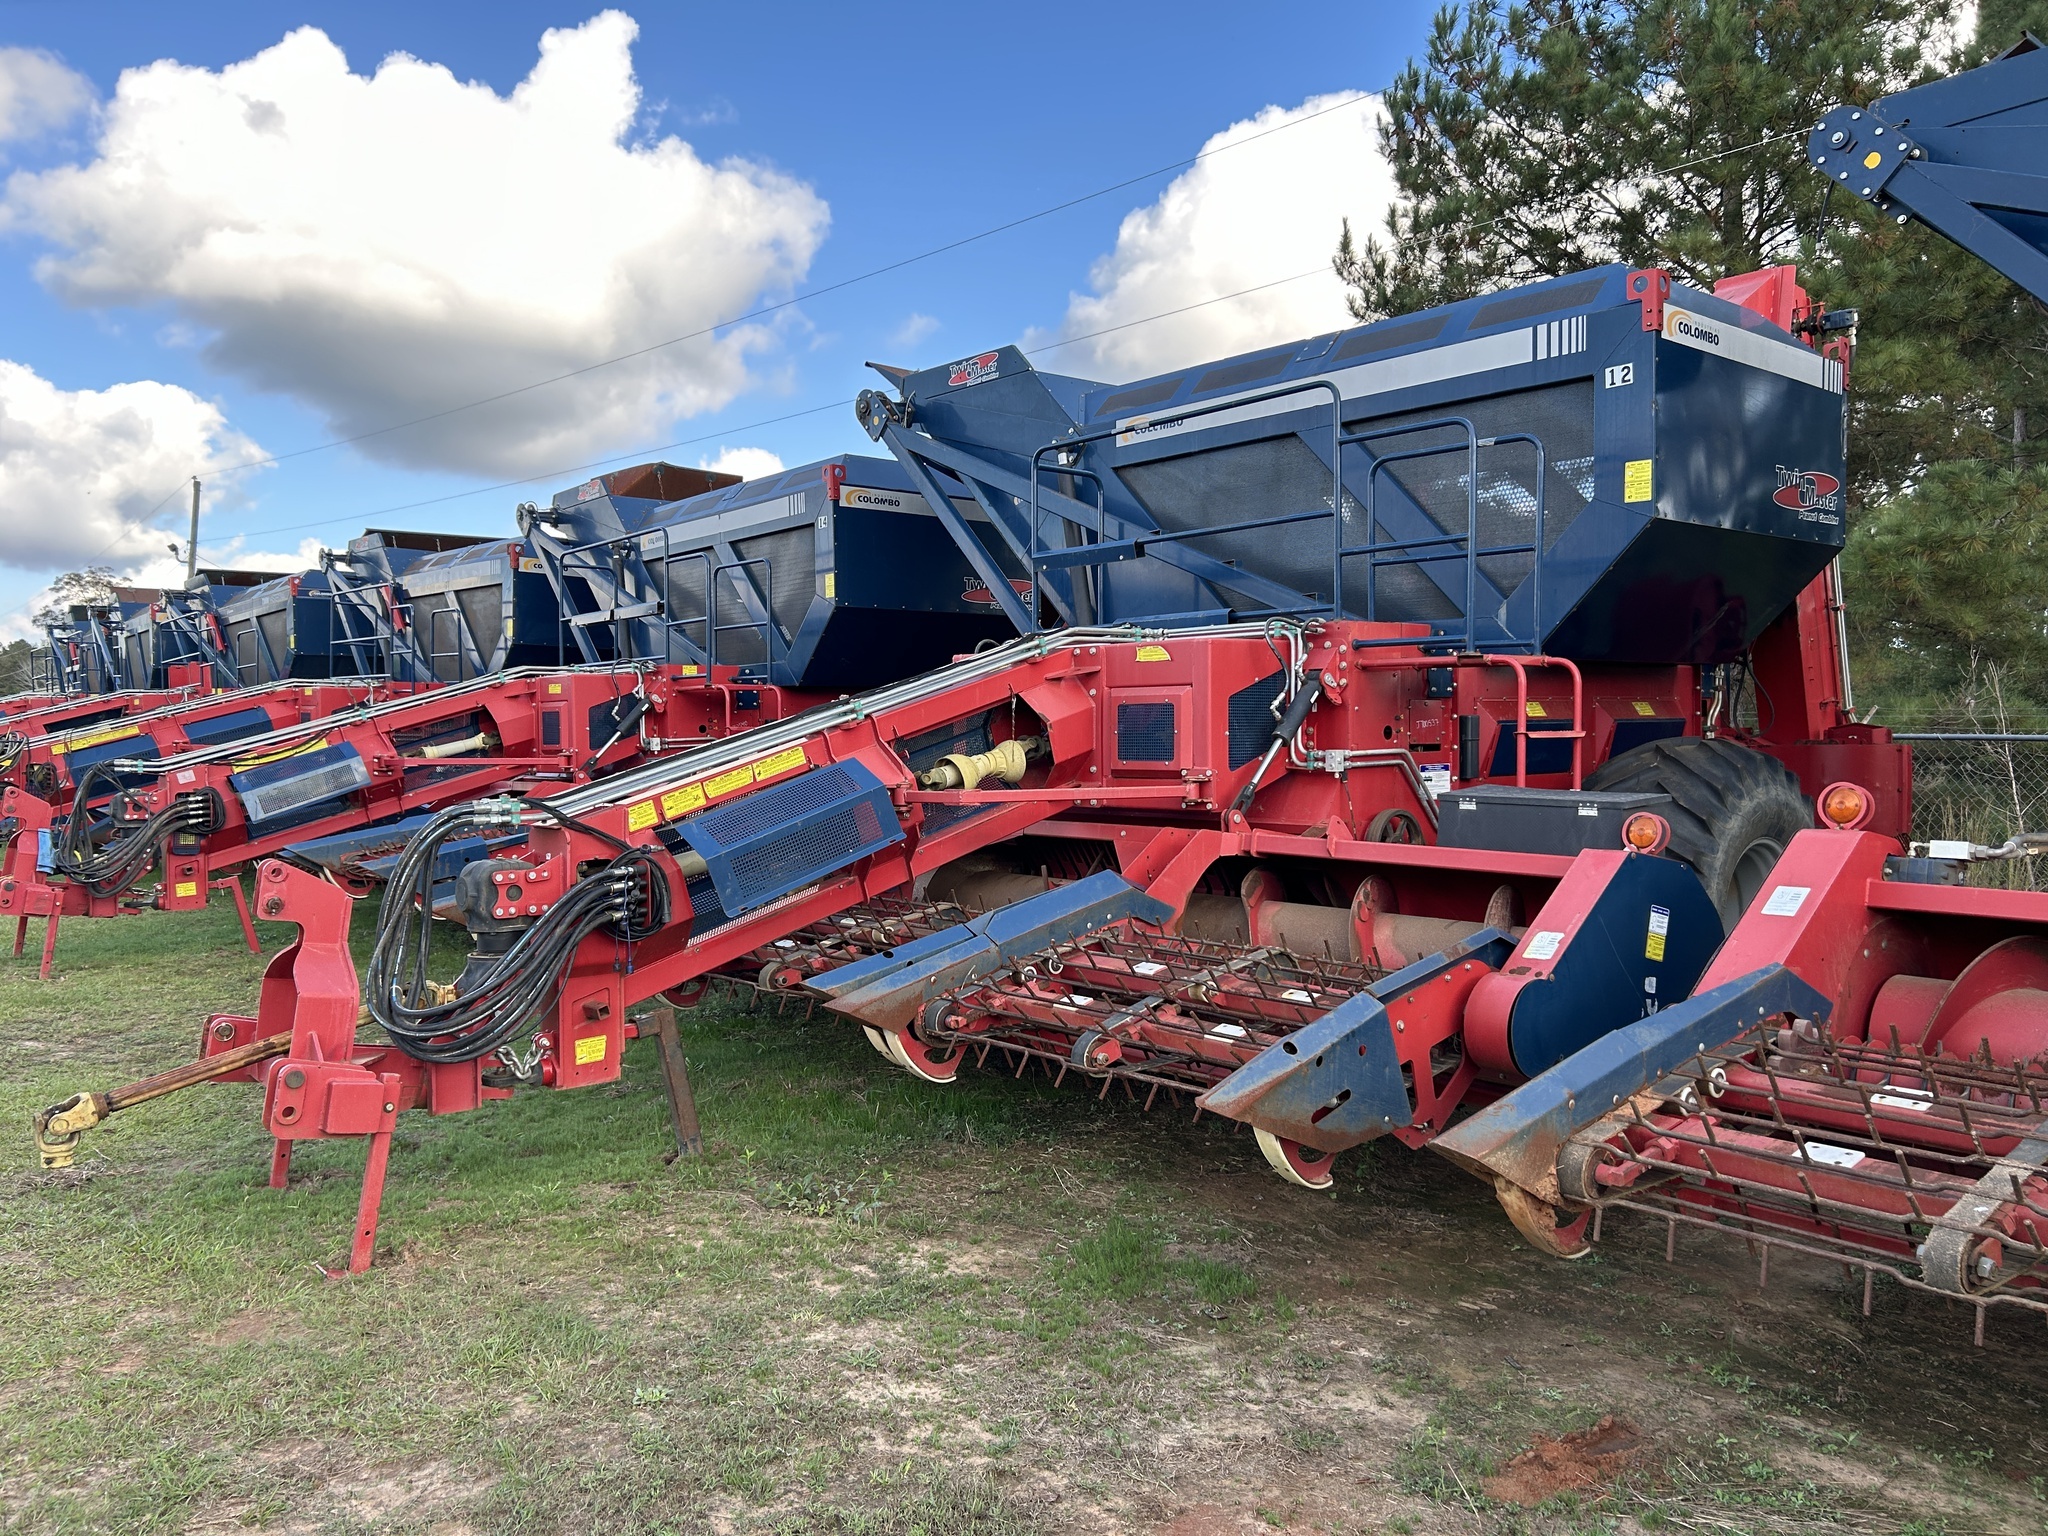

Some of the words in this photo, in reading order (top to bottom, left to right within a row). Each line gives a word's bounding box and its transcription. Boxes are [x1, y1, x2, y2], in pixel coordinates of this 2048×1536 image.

[1678, 321, 1720, 346] COLOMBO
[1775, 464, 1806, 492] Twin
[857, 495, 901, 507] COLOMBO
[1804, 484, 1838, 512] Master
